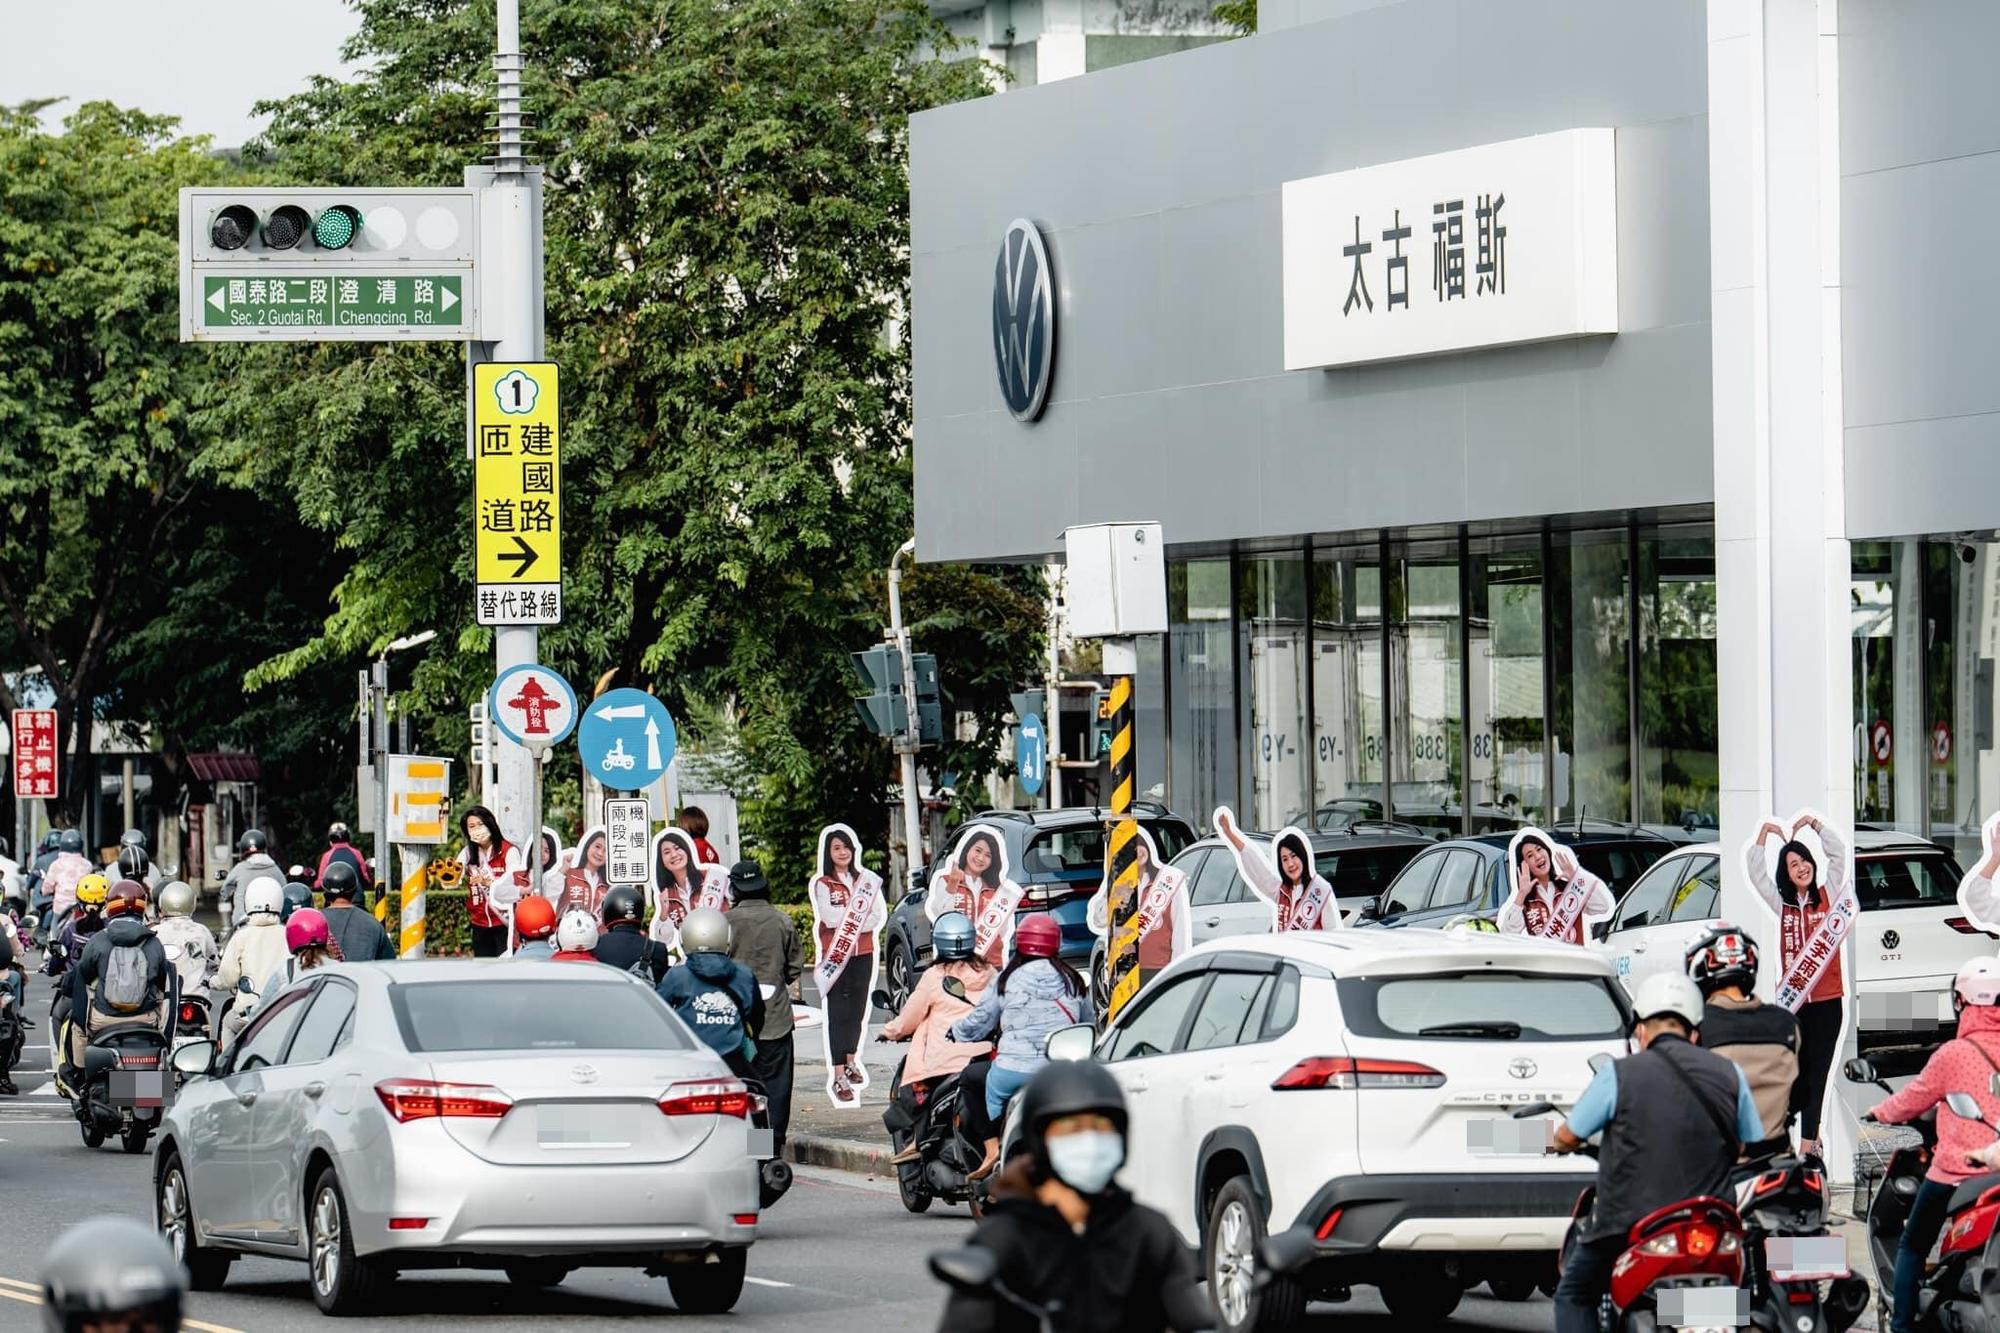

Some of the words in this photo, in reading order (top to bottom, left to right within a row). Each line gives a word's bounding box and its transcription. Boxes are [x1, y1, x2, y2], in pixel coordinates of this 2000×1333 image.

[1343, 192, 1506, 317] 太古福斯
[229, 280, 328, 304] 國泰路二段
[339, 280, 434, 304] 澄清路
[230, 310, 255, 325] Sec.
[258, 310, 265, 324] 2
[268, 309, 304, 325] Guotai
[307, 310, 326, 325] Rd.
[340, 310, 407, 326] Chengcing
[414, 310, 436, 325] Rd.
[511, 380, 521, 406] 1
[480, 424, 516, 532] 匝道
[520, 421, 554, 532] 建國路
[481, 590, 558, 619] 替代路線
[528, 696, 542, 728] 消防栓
[17, 712, 34, 795] 直行三多路
[35, 712, 54, 796] 禁止機車
[611, 805, 627, 879] 兩段左轉
[630, 805, 646, 877] 機慢車
[1880, 953, 1902, 961] GTI
[696, 1012, 736, 1025] Roots
